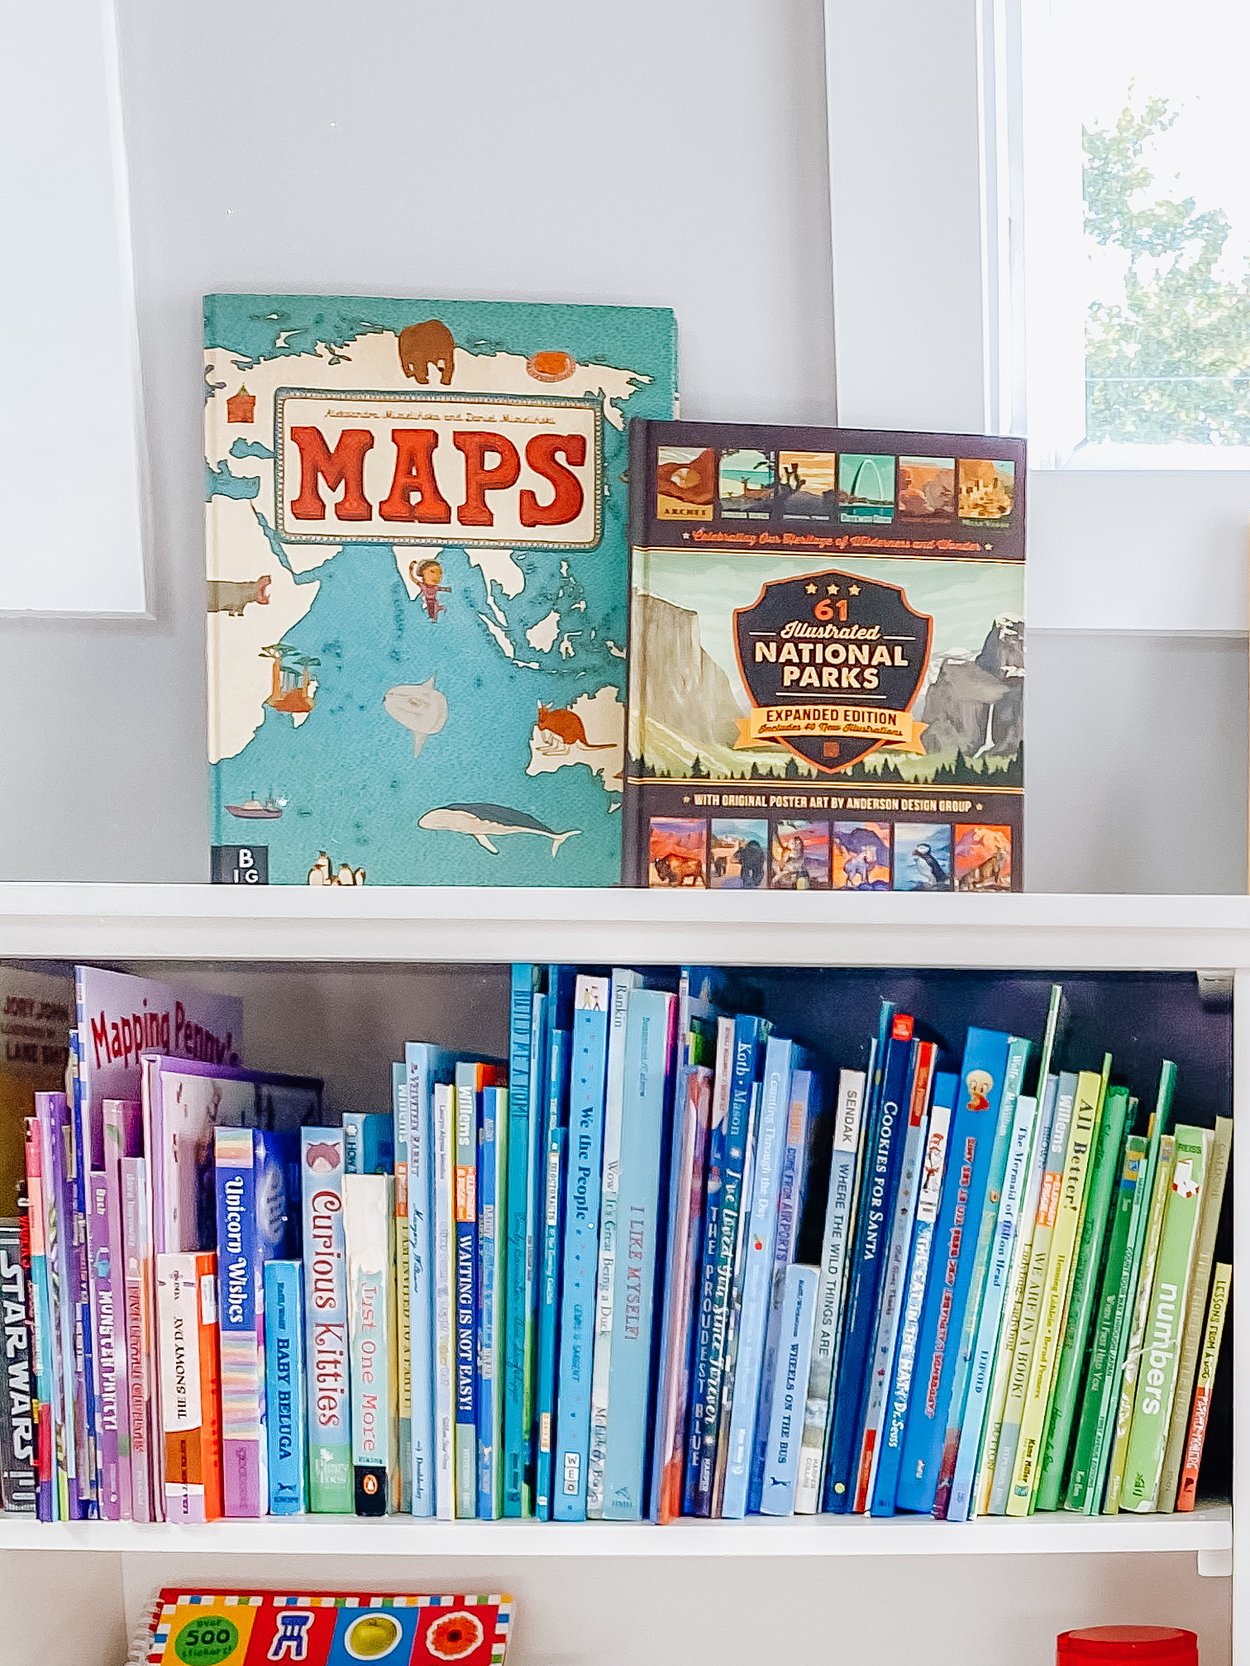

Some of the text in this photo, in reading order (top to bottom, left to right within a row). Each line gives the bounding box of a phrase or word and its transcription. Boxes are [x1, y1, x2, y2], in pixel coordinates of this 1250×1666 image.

[290, 426, 587, 528] MAPS
[781, 621, 881, 640] Illustrated
[815, 600, 848, 622] 61
[755, 642, 908, 667] NATIONAL
[783, 666, 879, 690] PARKS
[766, 709, 897, 725] EXPANDED EDITION
[694, 794, 972, 812] WITH ORIGINAL POSTER ART BY ANDERSON DESIGN GROUP
[614, 984, 628, 1028] Rankin
[458, 1085, 472, 1145] Willems
[1051, 1094, 1072, 1153] Willems
[573, 1106, 594, 1220] We the People
[863, 1101, 898, 1260] COOKIES FOR SANTA
[1063, 1099, 1093, 1212] All Better!
[225, 1176, 247, 1323] Unicorn Wishes
[819, 1090, 857, 1354] SENDAK WHERE THE WILD THINGS ARE
[0, 1251, 27, 1357] STAR
[312, 1190, 345, 1426] Curious Kitties
[459, 1235, 472, 1411] WAITING IS NOT EASY!
[1010, 1252, 1046, 1398] WE ARE IN A BOOK!
[277, 1338, 290, 1384] BABY
[362, 1282, 378, 1450] Just One More
[785, 1343, 799, 1390] WHEELS
[1141, 1283, 1179, 1415] numbers
[8, 1359, 33, 1466] WARS
[278, 1390, 291, 1459] BELUGA
[781, 1415, 792, 1437] THE
[784, 1394, 794, 1410] ON
[778, 1441, 790, 1464] BUS
[184, 1629, 230, 1647] 500
